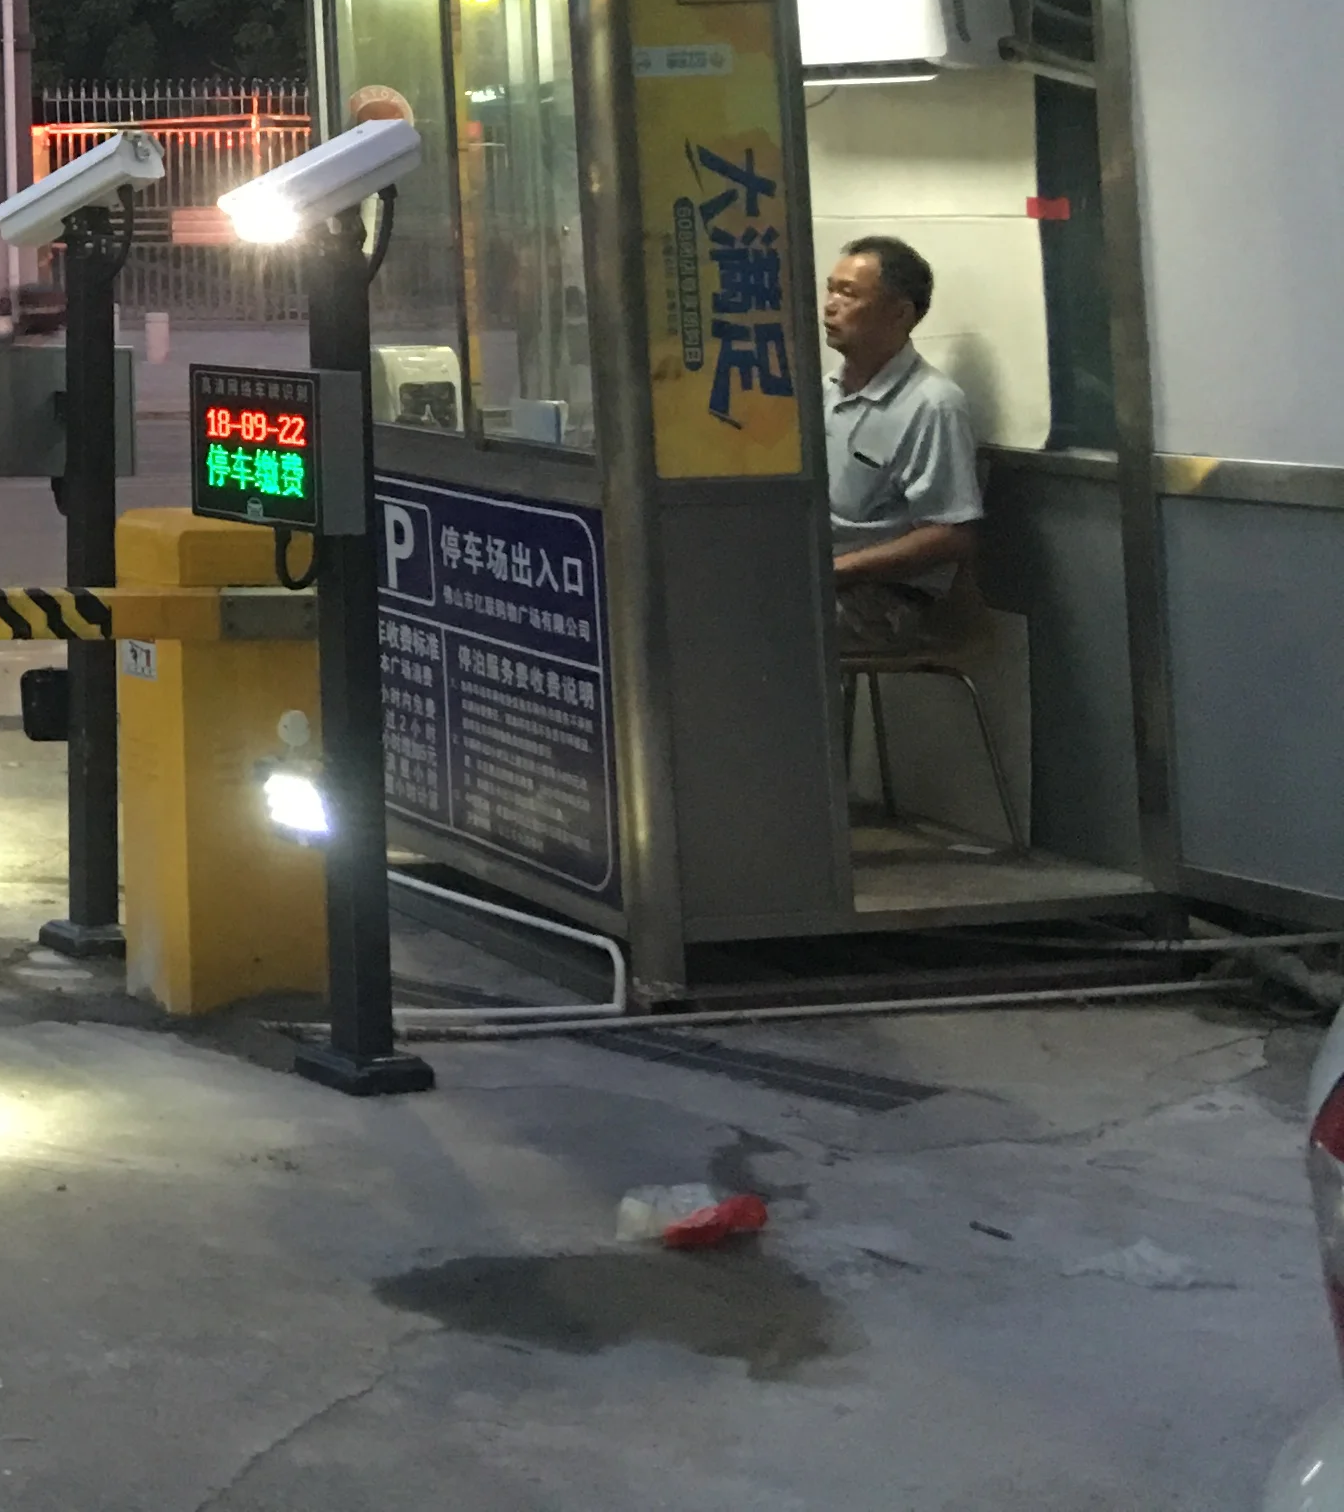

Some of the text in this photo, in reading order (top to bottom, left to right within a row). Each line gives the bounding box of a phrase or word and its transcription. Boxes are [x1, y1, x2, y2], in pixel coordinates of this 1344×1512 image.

[696, 141, 794, 430] 大满足
[206, 407, 307, 447] 18-09-22
[206, 443, 305, 498] 停车缴费
[384, 502, 415, 590] P
[440, 524, 585, 597] 停车场出入口
